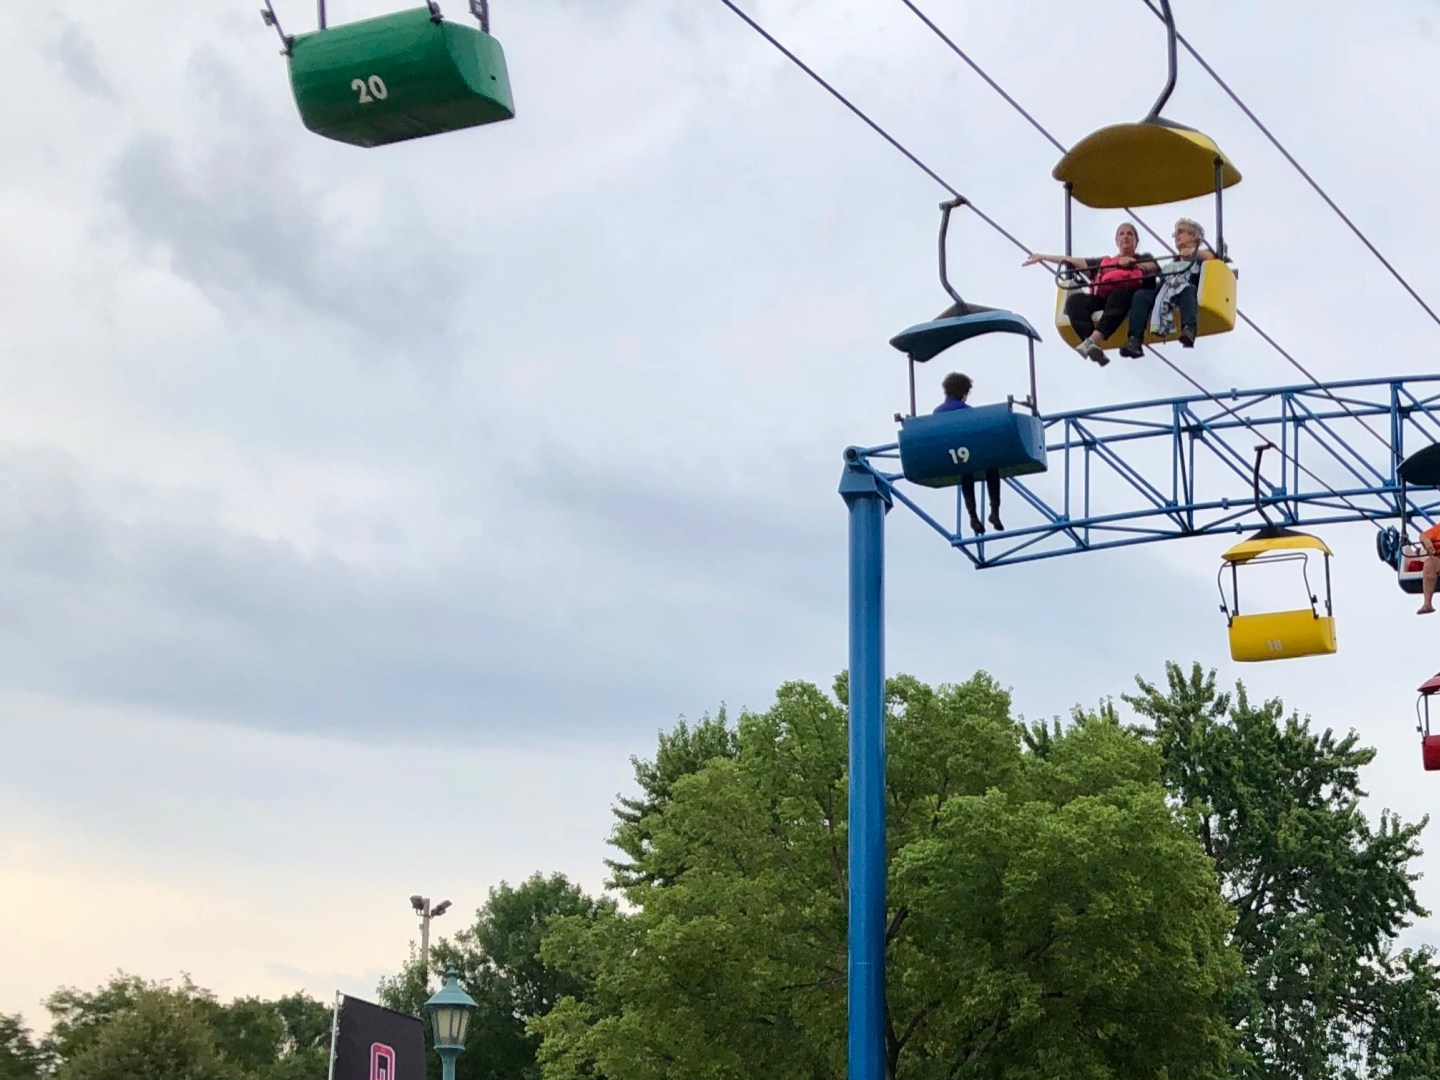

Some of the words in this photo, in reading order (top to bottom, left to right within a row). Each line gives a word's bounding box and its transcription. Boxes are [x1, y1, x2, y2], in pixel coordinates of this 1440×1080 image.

[351, 74, 388, 104] 20
[949, 446, 970, 465] 19
[1266, 639, 1283, 652] 18
